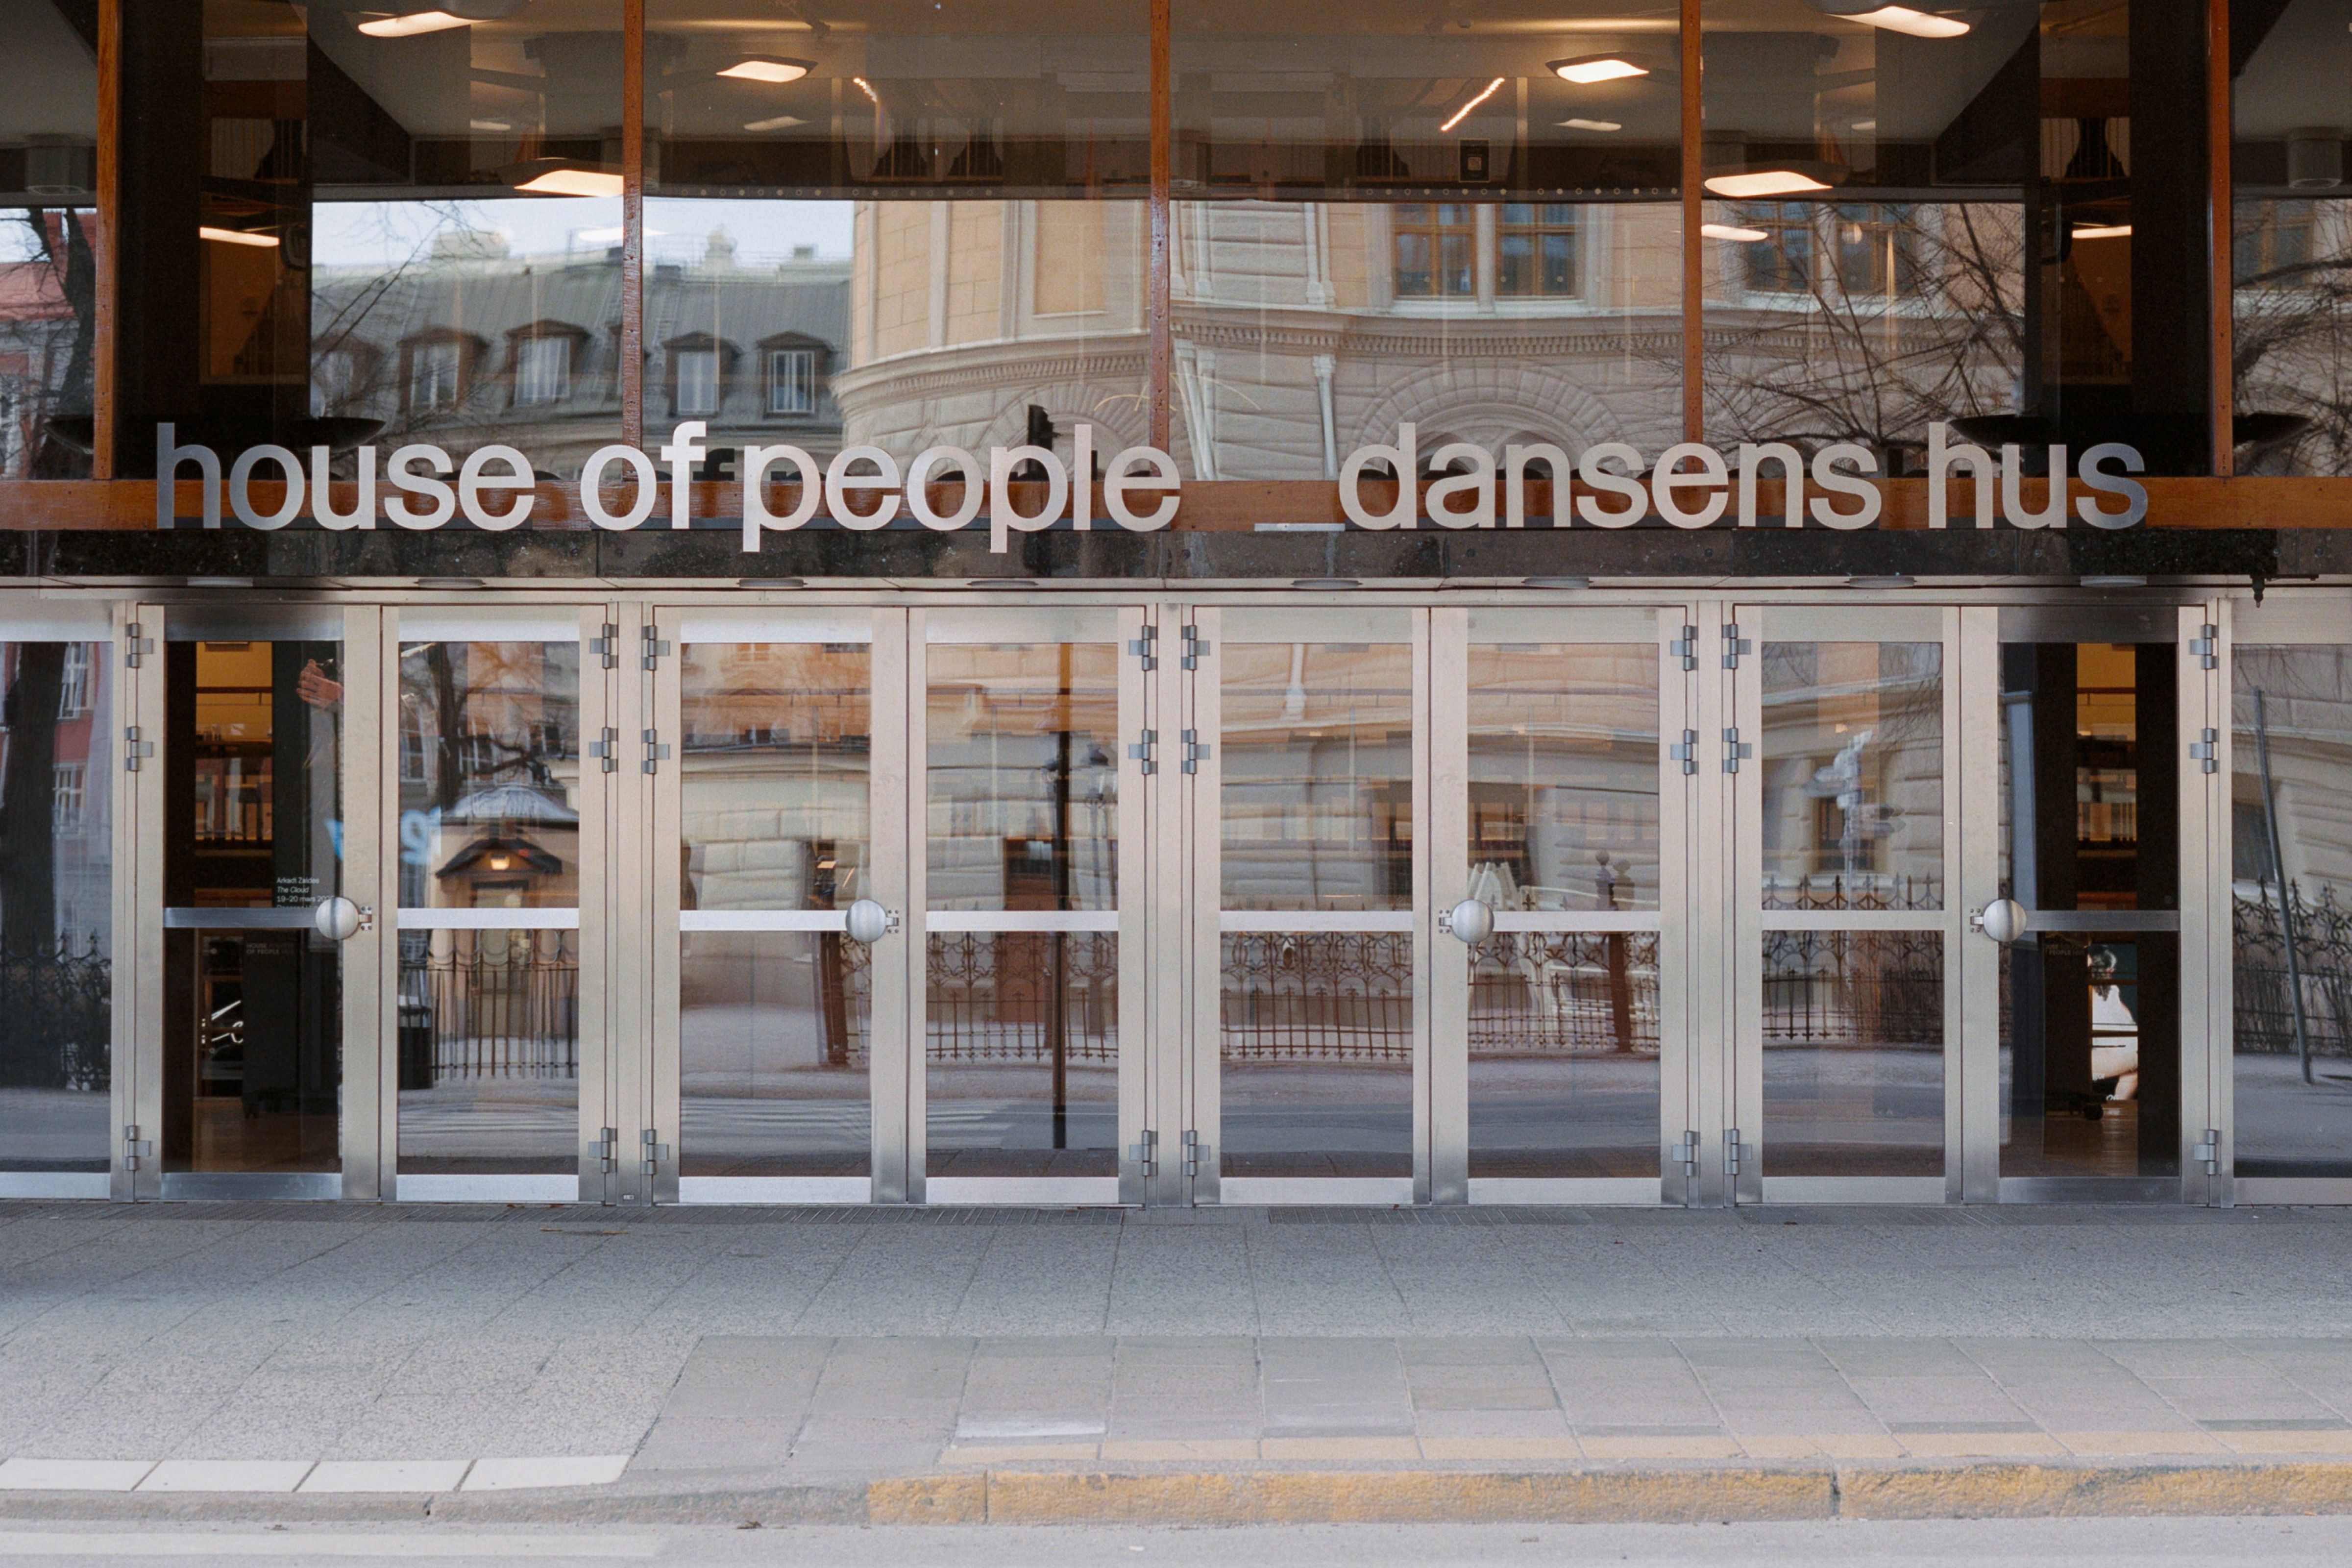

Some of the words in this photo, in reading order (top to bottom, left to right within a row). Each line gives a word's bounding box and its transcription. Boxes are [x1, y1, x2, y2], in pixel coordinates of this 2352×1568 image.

[156, 422, 535, 530] house
[580, 422, 706, 530] of
[742, 424, 1180, 553] people
[1338, 422, 1882, 530] dansens
[1929, 422, 2148, 531] hus
